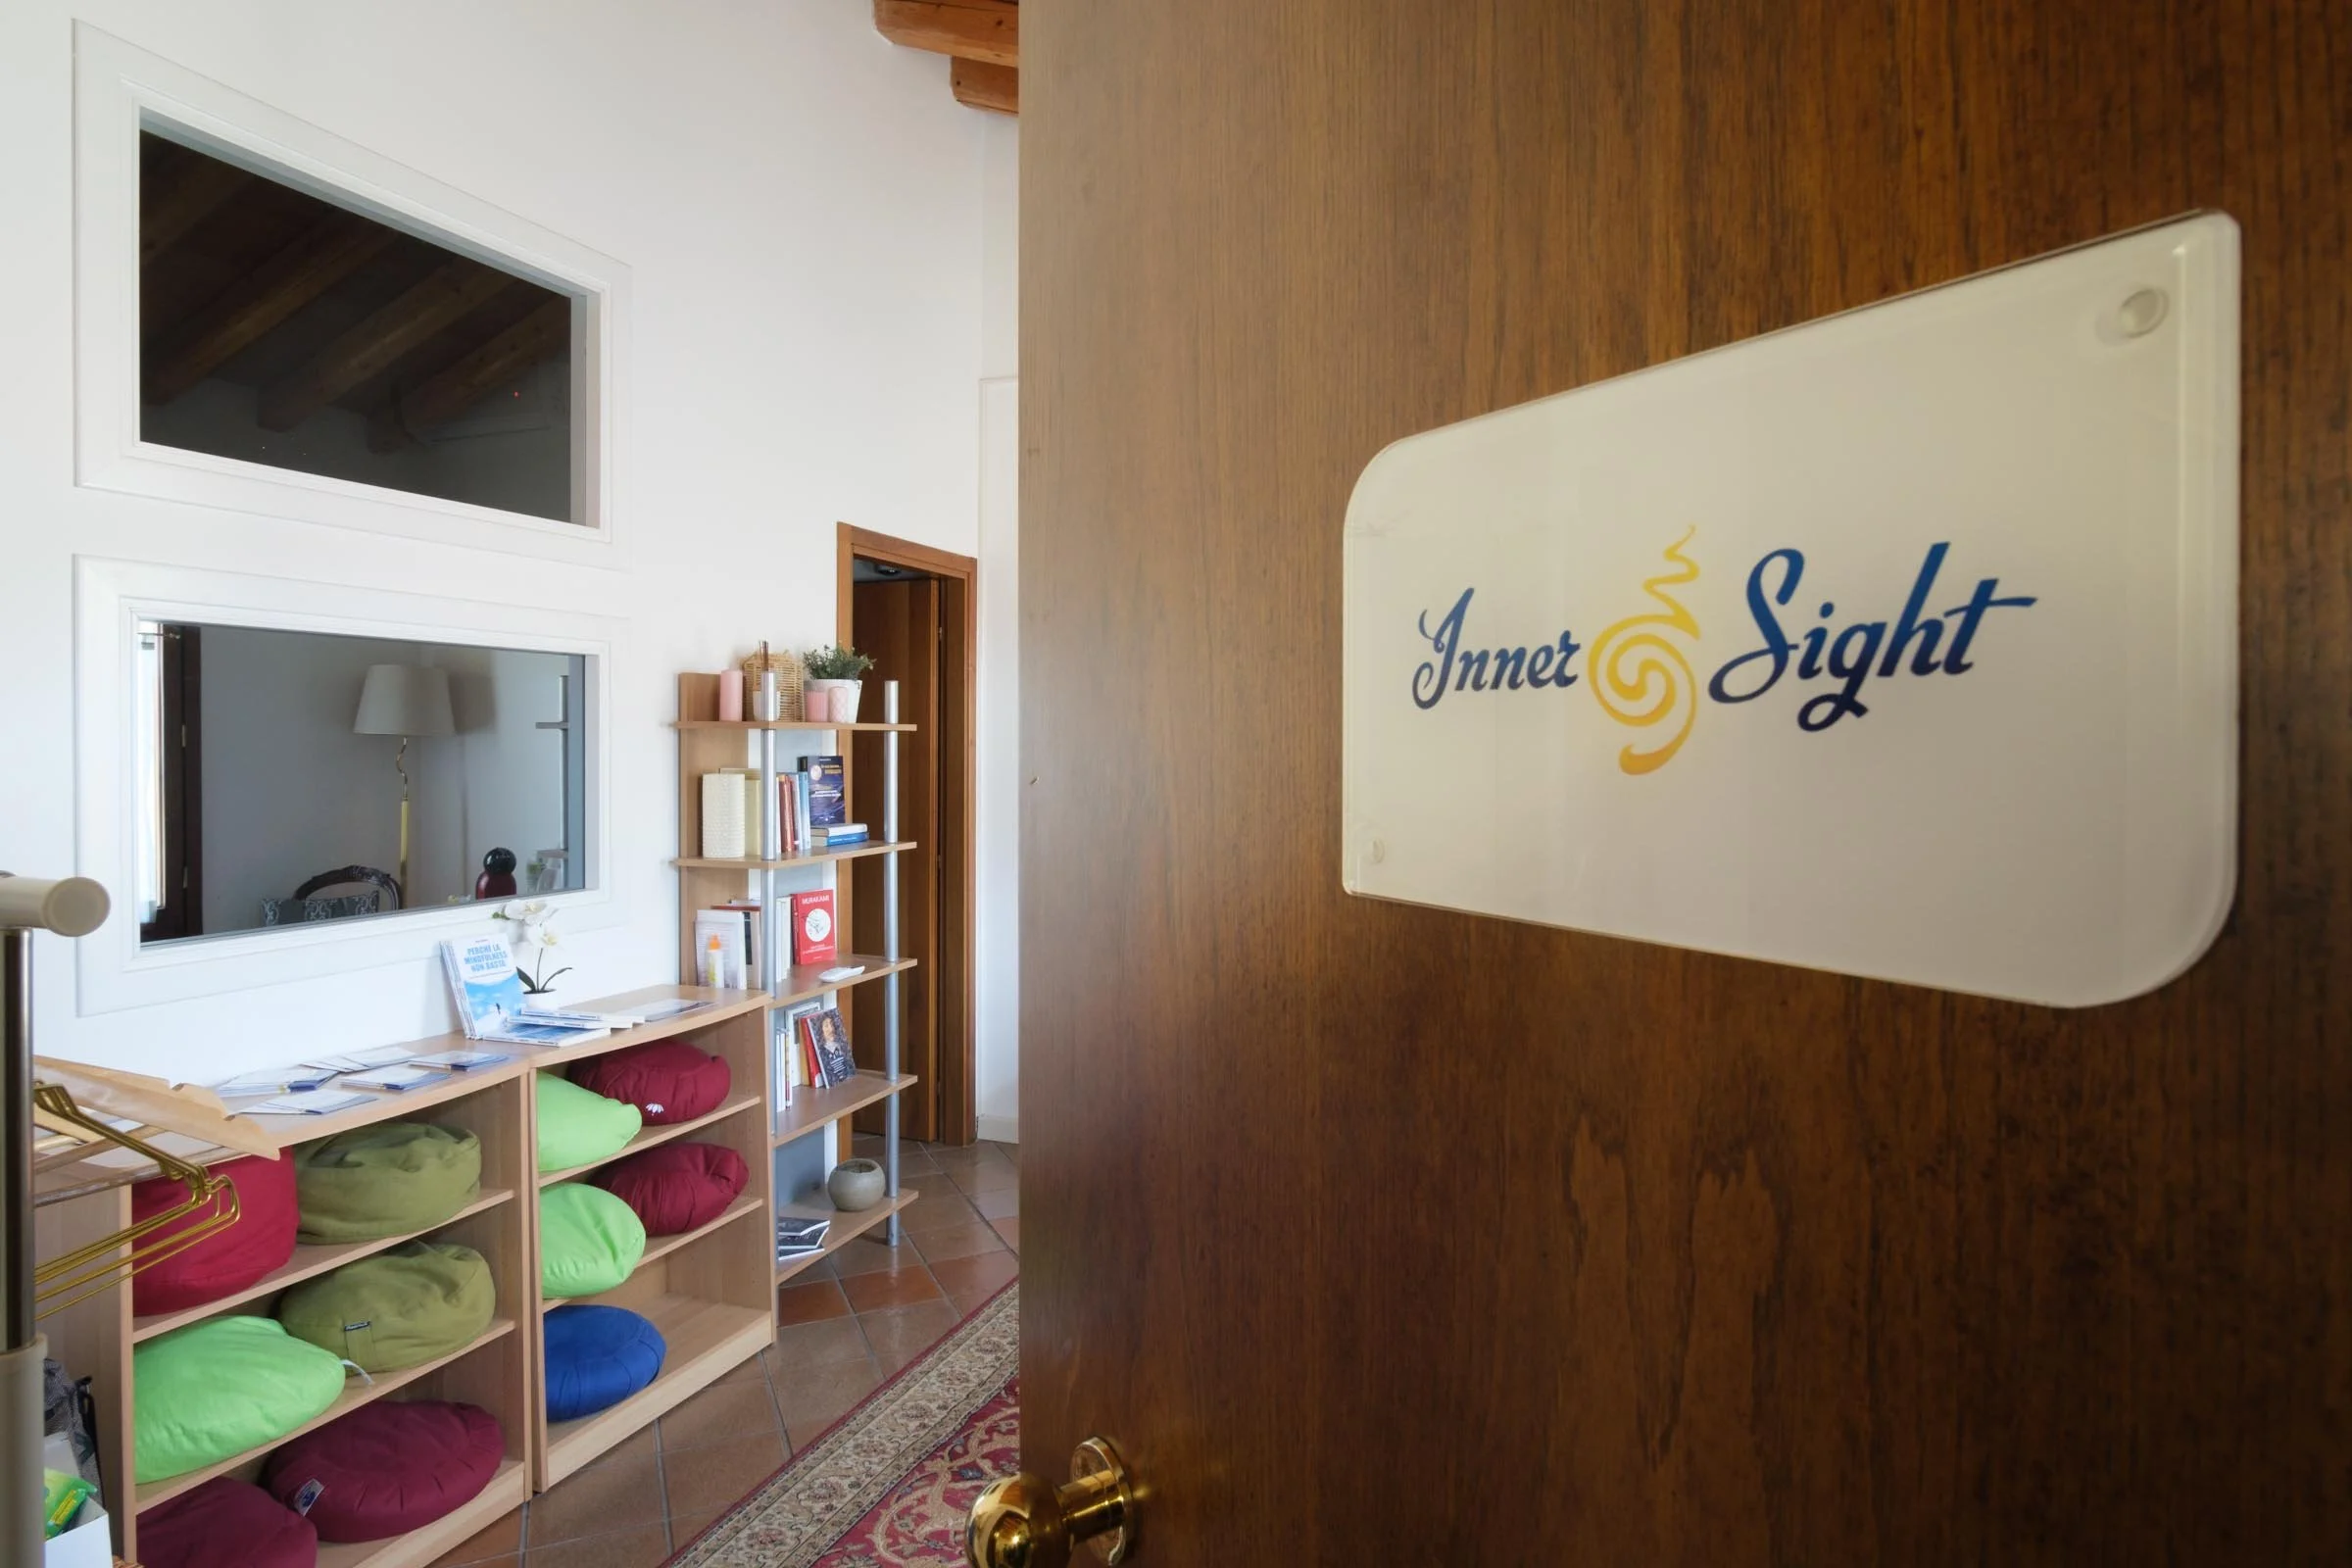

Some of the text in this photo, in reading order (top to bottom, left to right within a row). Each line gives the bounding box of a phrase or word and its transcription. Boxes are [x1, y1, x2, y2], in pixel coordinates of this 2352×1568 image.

[1412, 542, 2038, 732] Inner Sight
[801, 894, 830, 906] MURAKAMI
[464, 951, 508, 964] MINDFULNESS
[470, 959, 507, 972] NON BASTA
